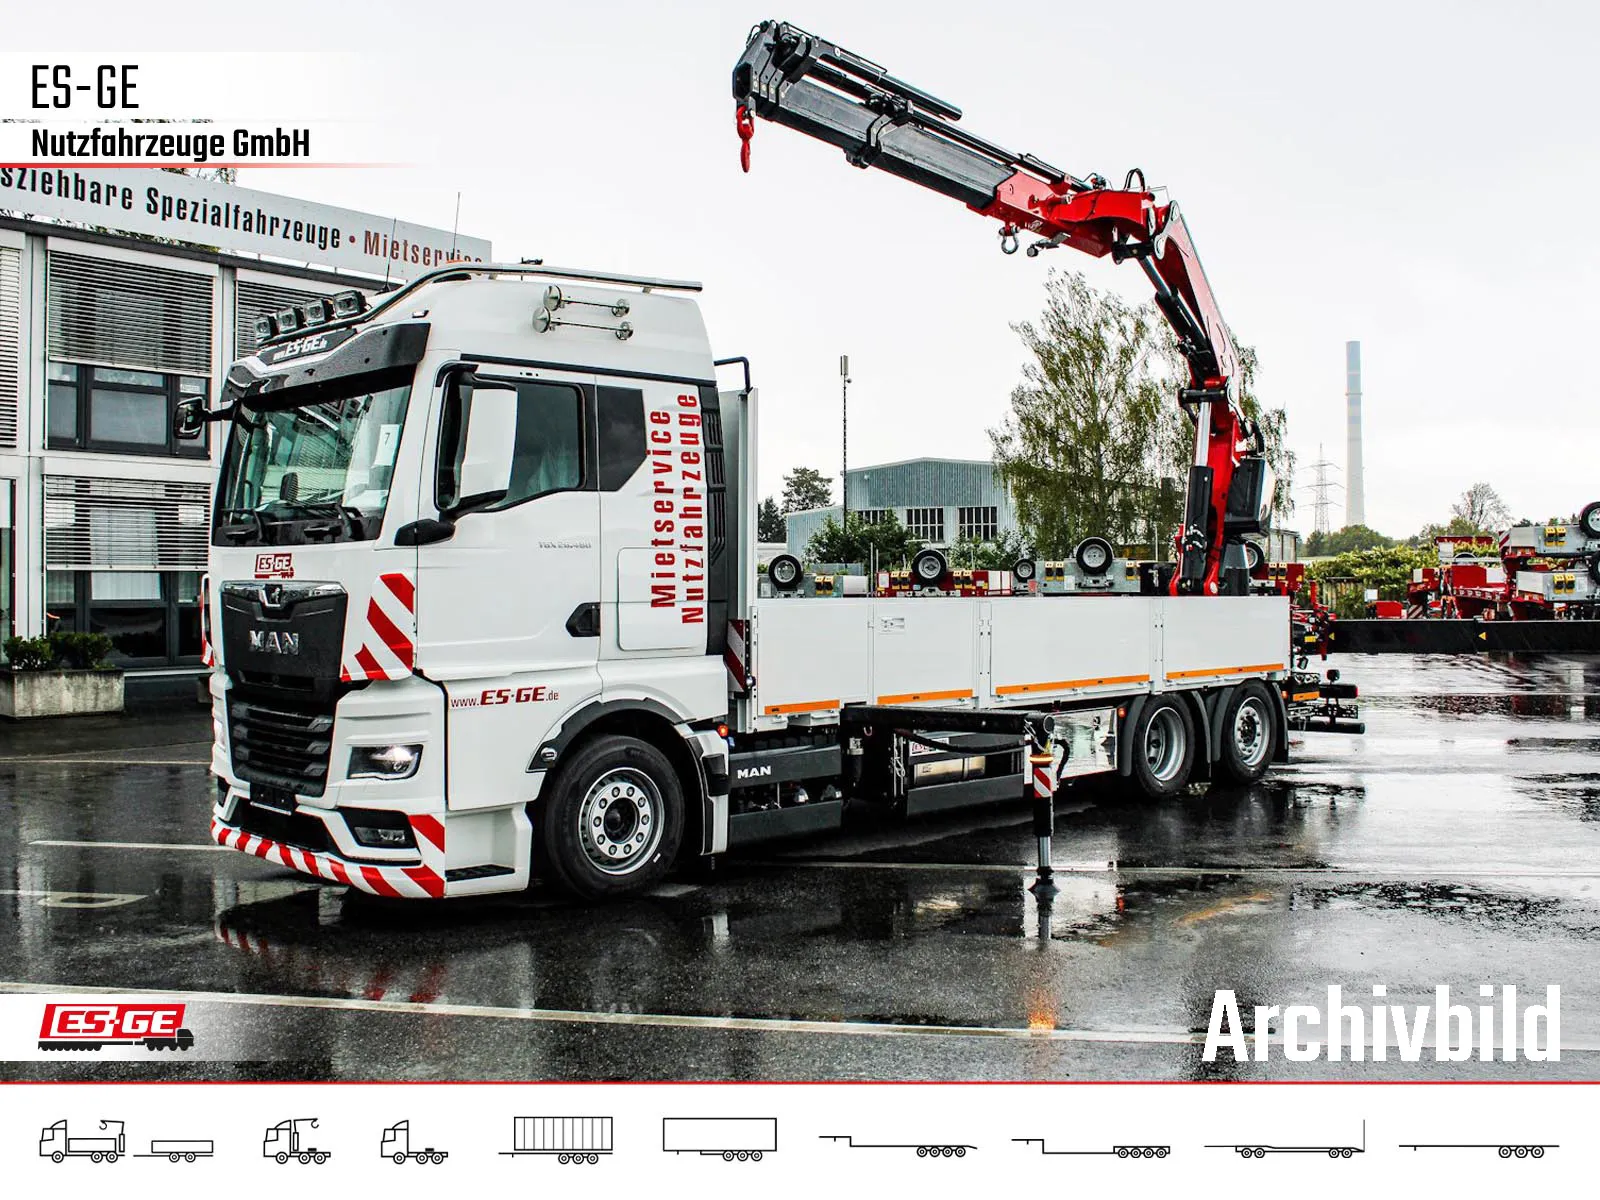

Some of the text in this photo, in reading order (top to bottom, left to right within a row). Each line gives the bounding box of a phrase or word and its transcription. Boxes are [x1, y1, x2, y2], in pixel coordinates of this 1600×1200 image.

[146, 186, 340, 249] Spezialfahrzeuge
[363, 230, 482, 267] Mietservi
[384, 432, 391, 446] 7
[646, 410, 676, 608] Mietservice
[677, 394, 704, 624] Nutzfahrzeuge
[249, 630, 299, 655] MAN
[737, 766, 772, 780] MAN
